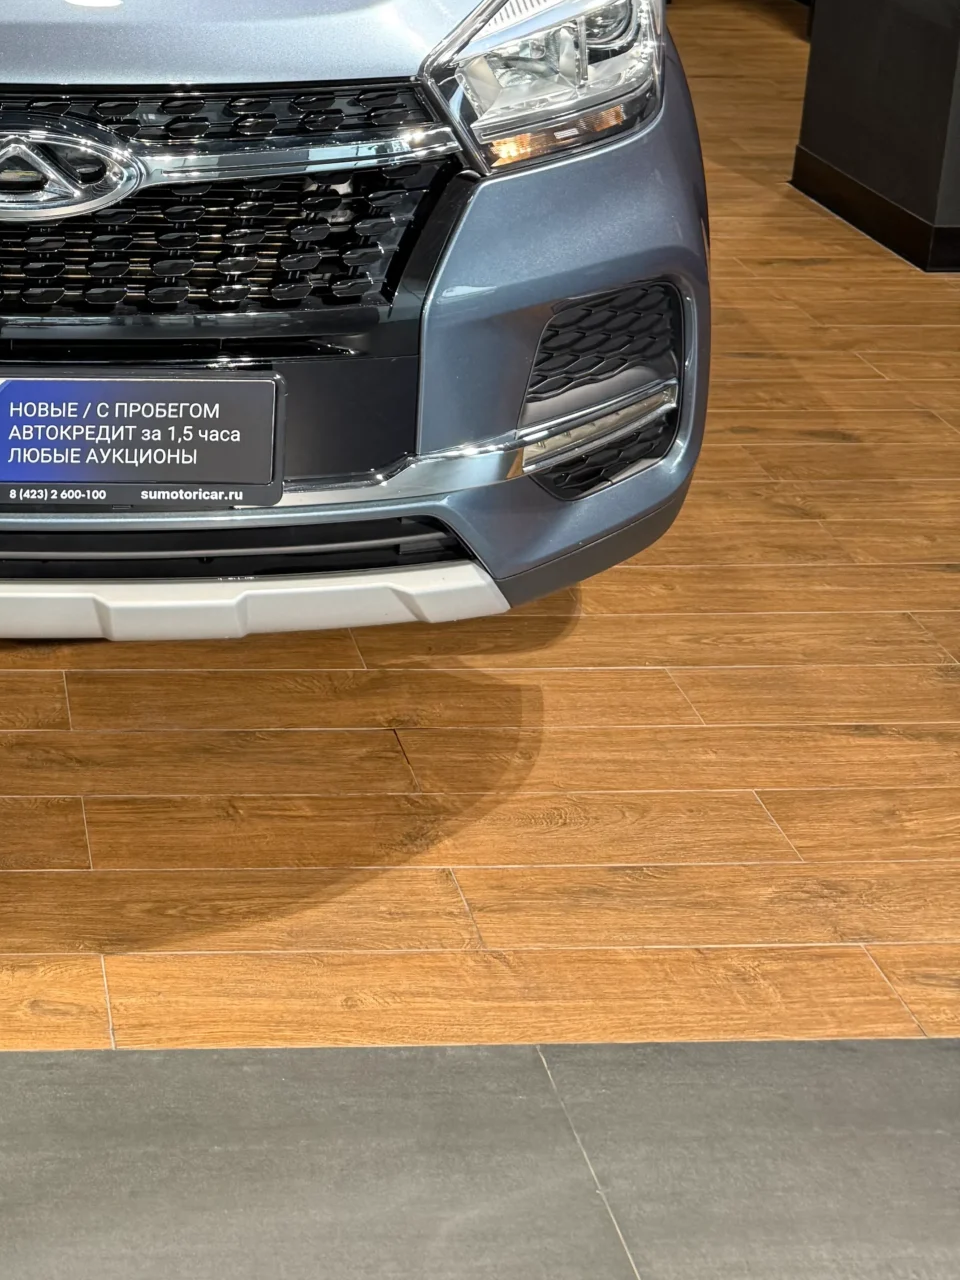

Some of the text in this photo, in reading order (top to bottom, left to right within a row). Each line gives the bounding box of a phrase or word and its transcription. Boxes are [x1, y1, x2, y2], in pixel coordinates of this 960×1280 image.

[9, 402, 220, 419] НОВЫЕ / С ПРОБЕГОМ
[8, 424, 241, 443] АВТОКРЕДИТ за 1,5 часа
[7, 447, 198, 467] ЛЮБЫЕ АУКЦИОНЫ
[9, 489, 107, 501] 8 (423) 2 600-100
[140, 489, 244, 501] sumotoricar.ru
